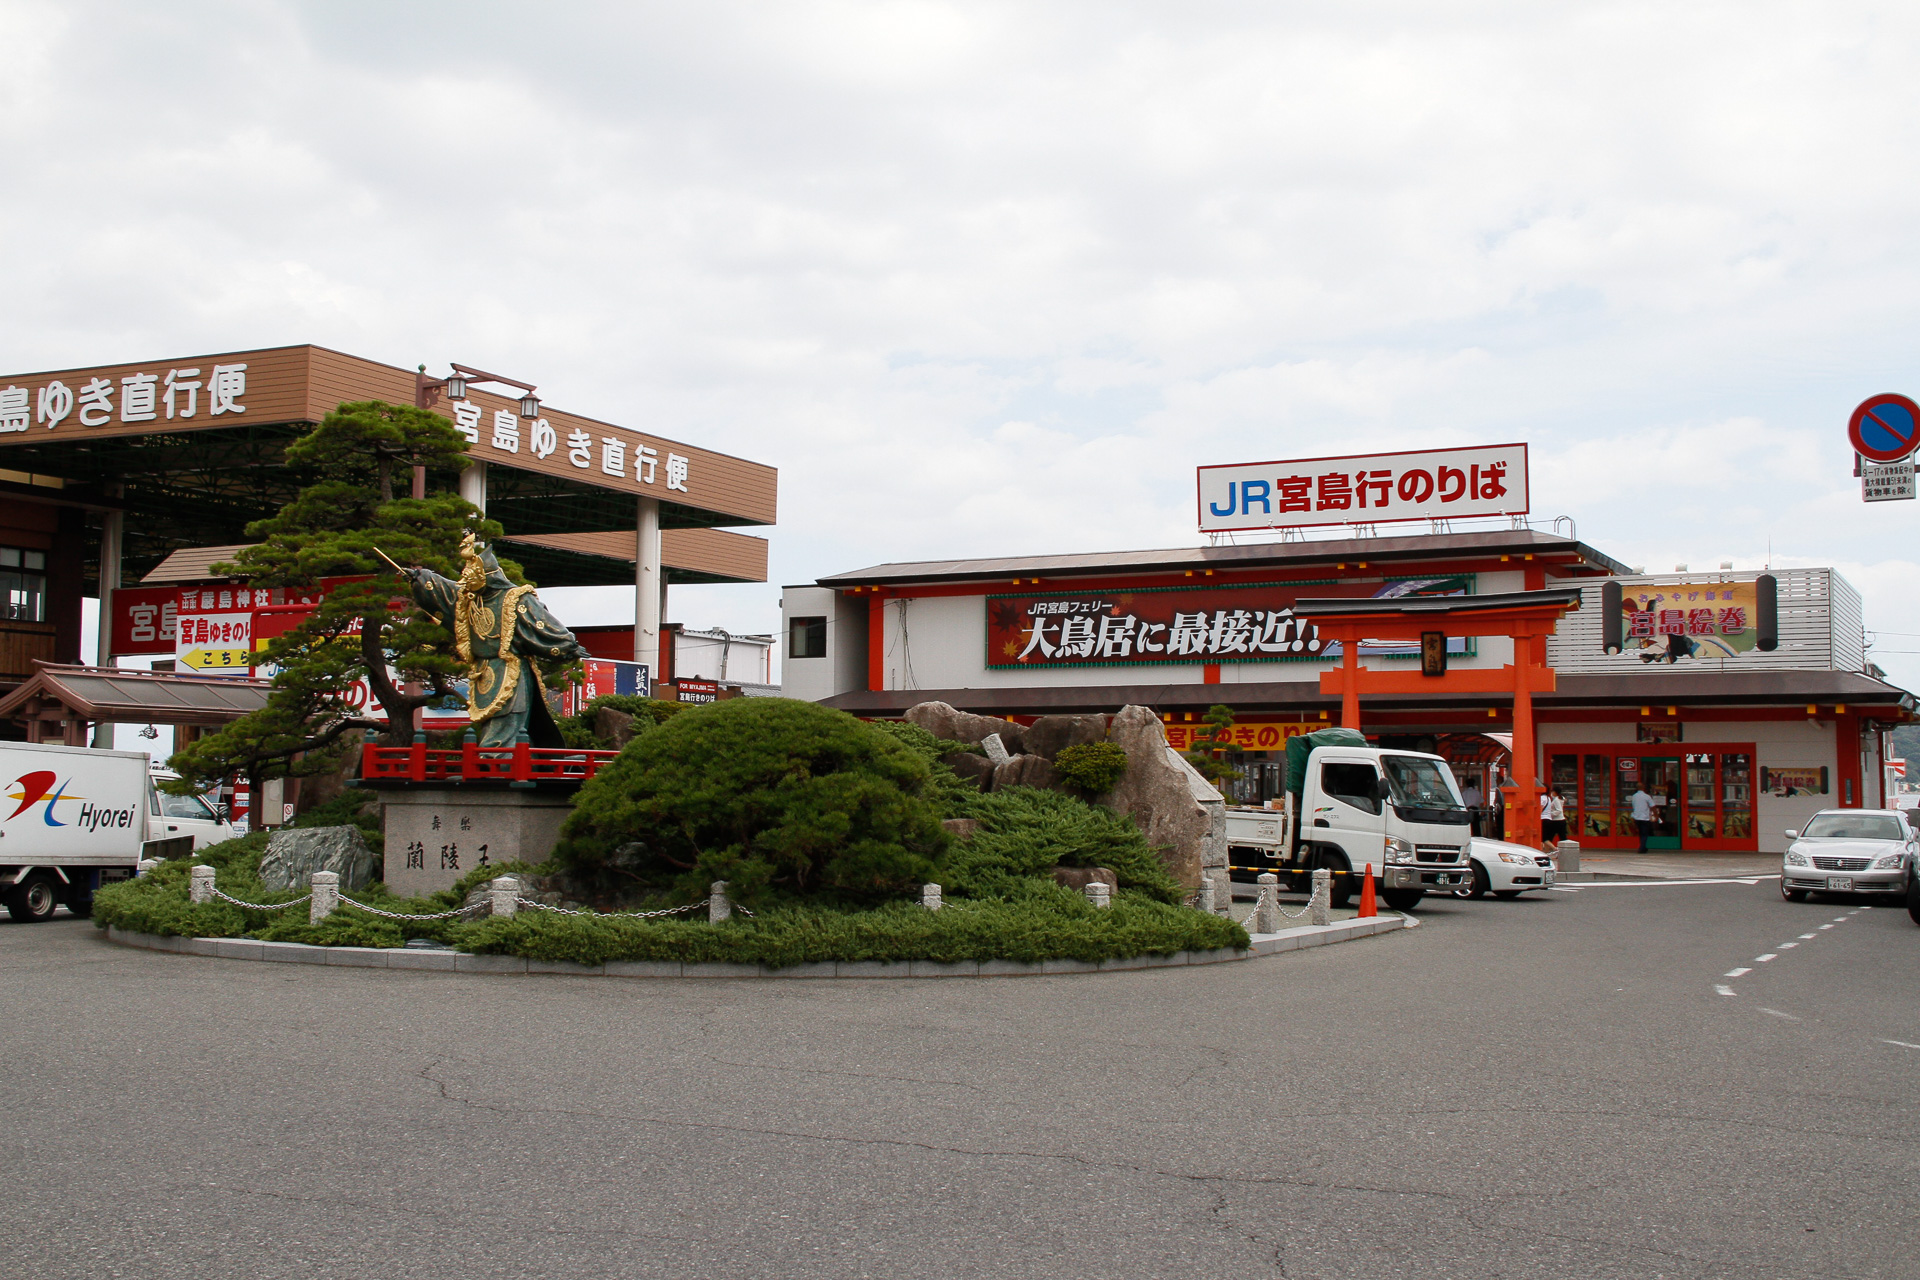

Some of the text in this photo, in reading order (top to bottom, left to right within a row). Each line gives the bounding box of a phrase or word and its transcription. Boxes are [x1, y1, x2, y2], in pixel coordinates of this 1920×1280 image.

[453, 400, 689, 492] 宮島ゆき直行便
[1210, 460, 1507, 517] JR宮島行のりば
[1865, 486, 1911, 497] 貨物車を除く
[1027, 600, 1113, 615] JR宮島フェリー
[1629, 606, 1746, 637] 宮島絵巻
[1017, 608, 1320, 659] 大鳥居に最接近!!
[203, 650, 249, 665] こちら
[78, 803, 136, 833] Hyorei
[407, 841, 491, 870] 蘭陵王
